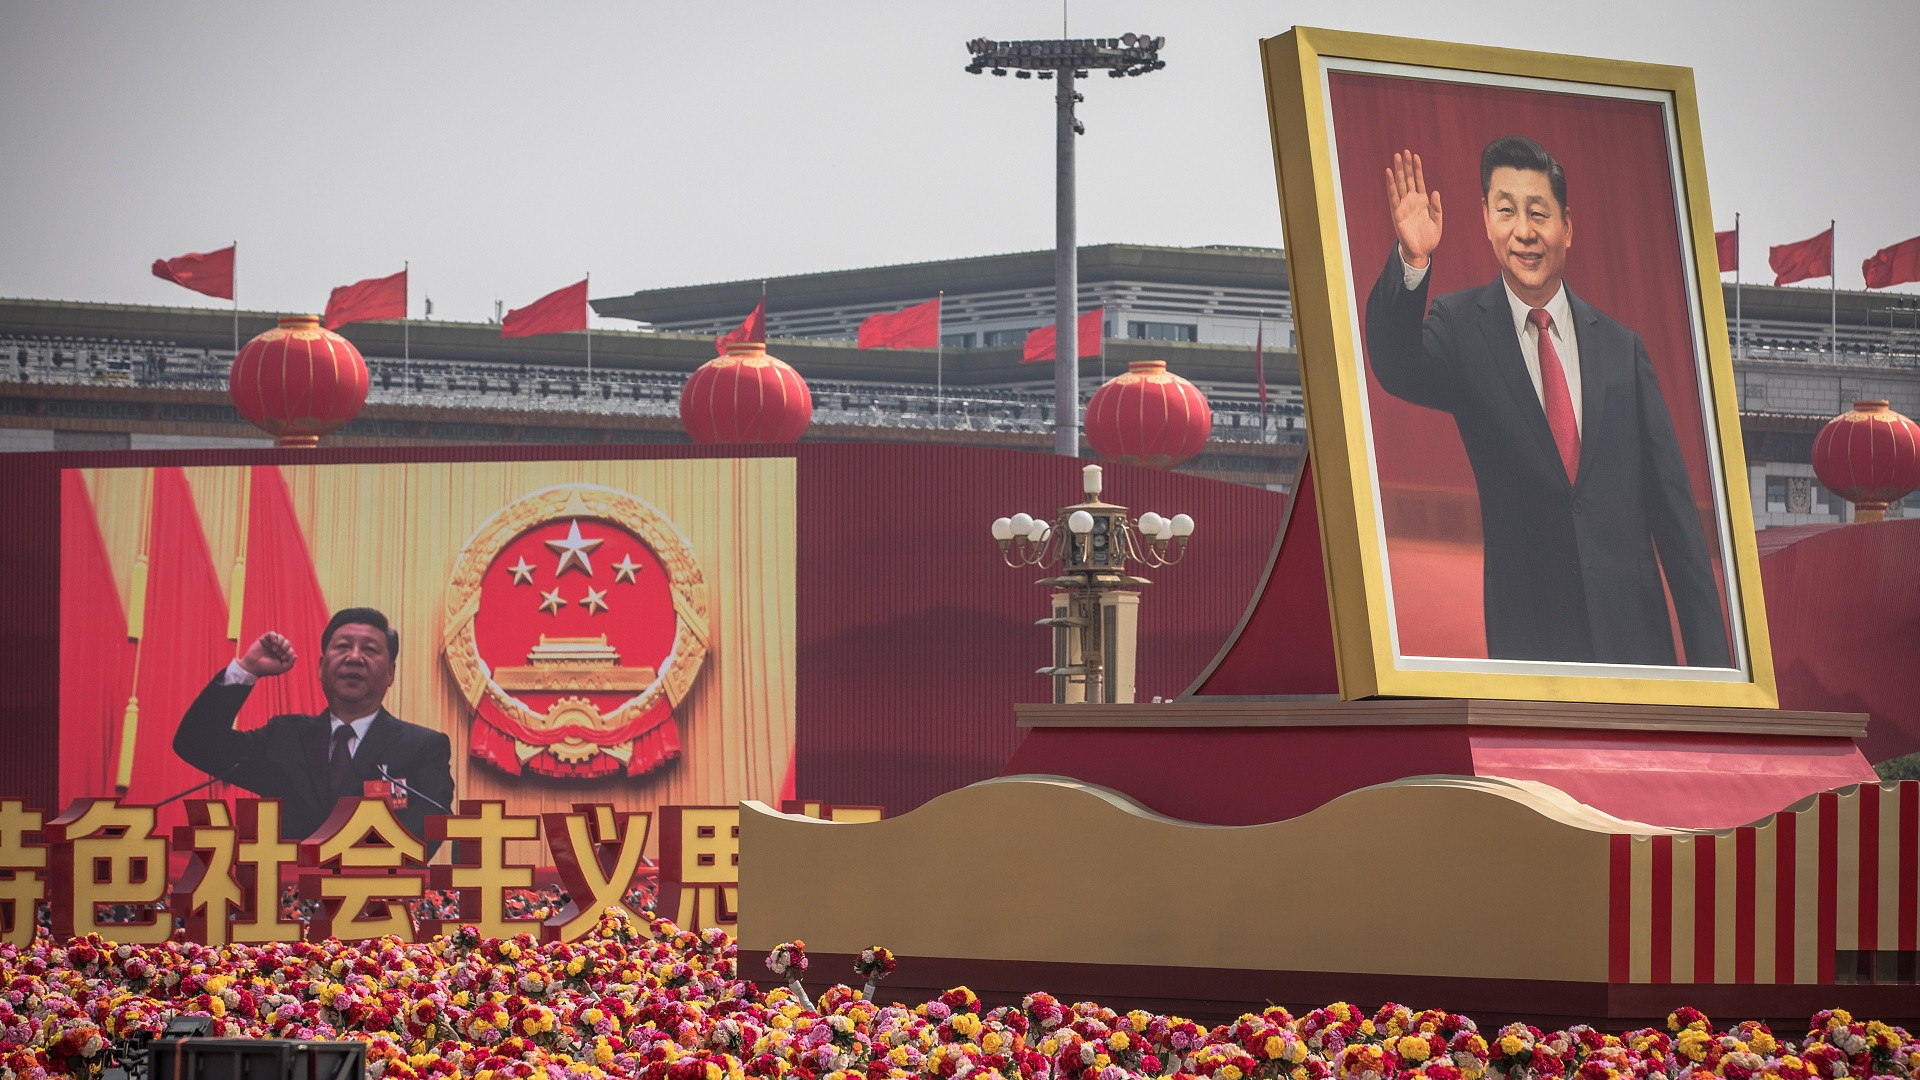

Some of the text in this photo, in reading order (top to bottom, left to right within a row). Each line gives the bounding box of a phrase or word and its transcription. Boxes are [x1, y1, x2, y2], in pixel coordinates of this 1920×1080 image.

[0, 797, 885, 947] 色社会主义思
